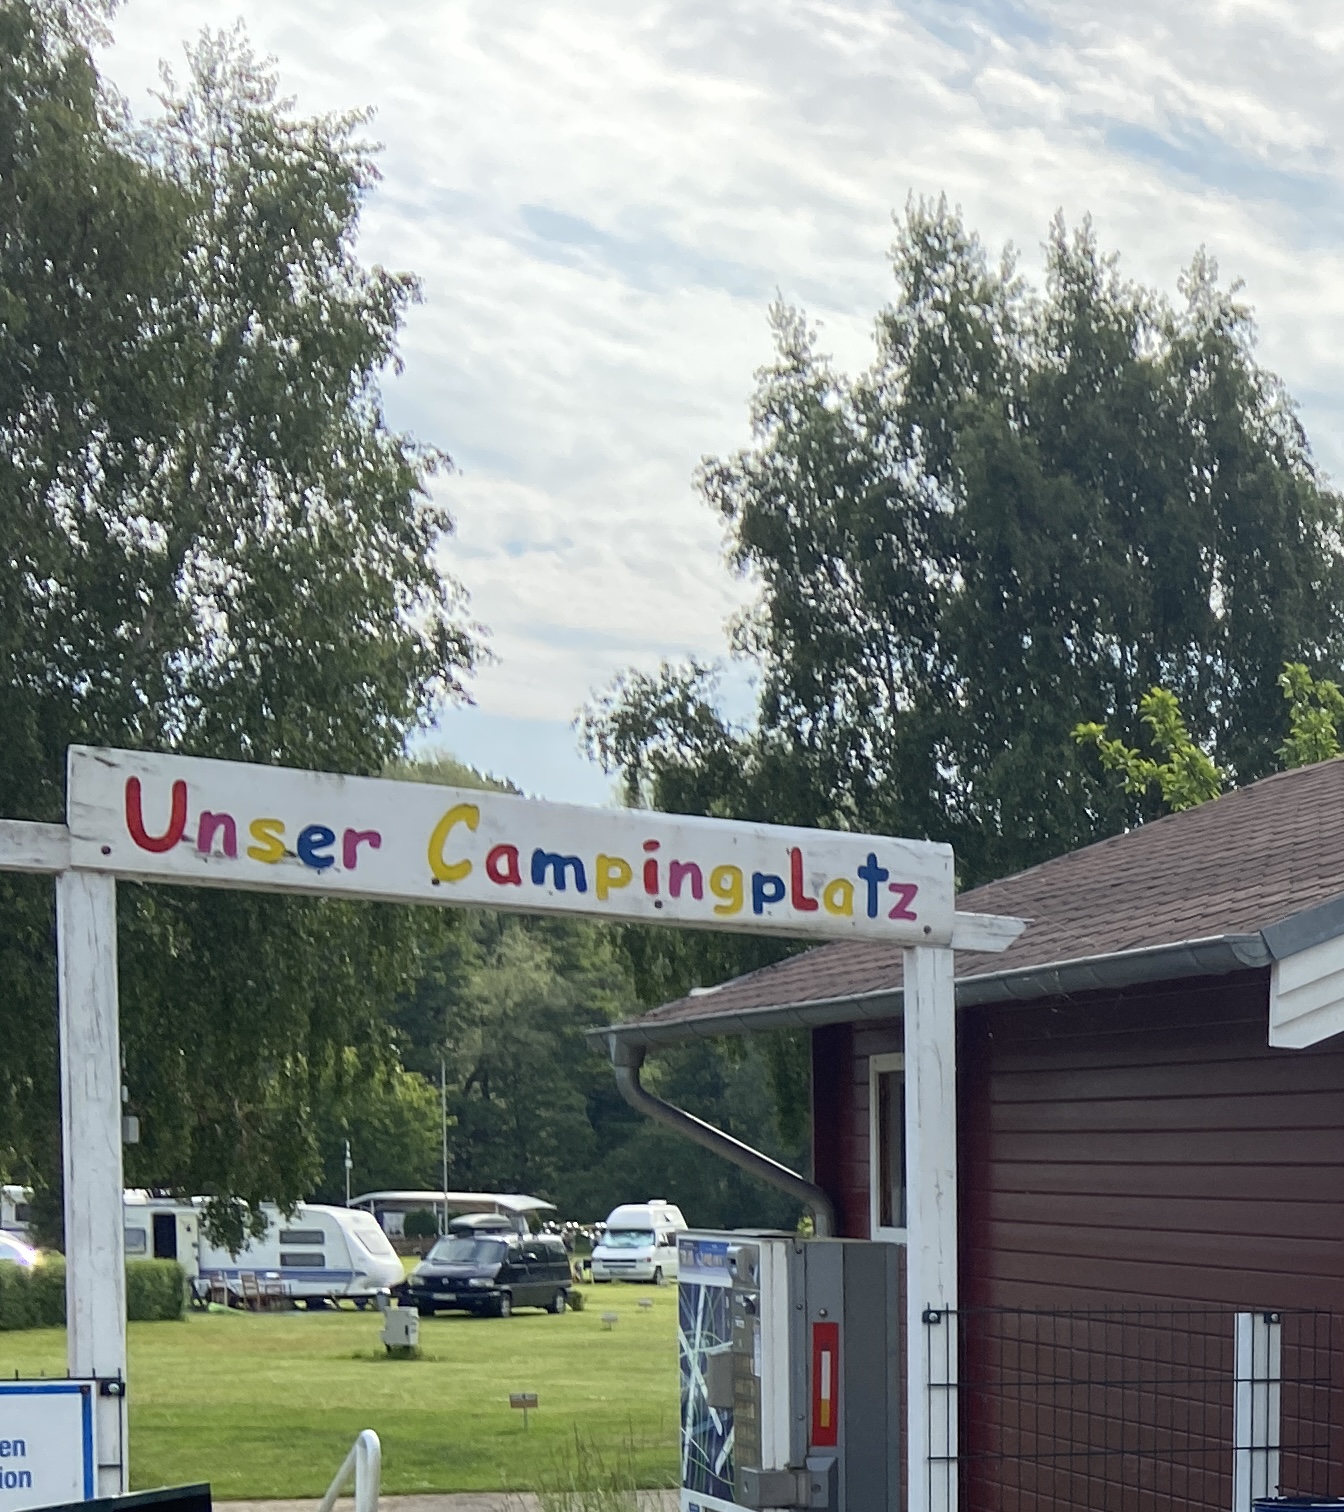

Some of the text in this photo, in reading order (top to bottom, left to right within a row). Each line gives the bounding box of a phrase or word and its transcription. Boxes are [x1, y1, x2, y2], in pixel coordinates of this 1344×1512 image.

[125, 777, 919, 923] Unser Campingplatz
[0, 1438, 26, 1458] en
[0, 1465, 32, 1489] ion
